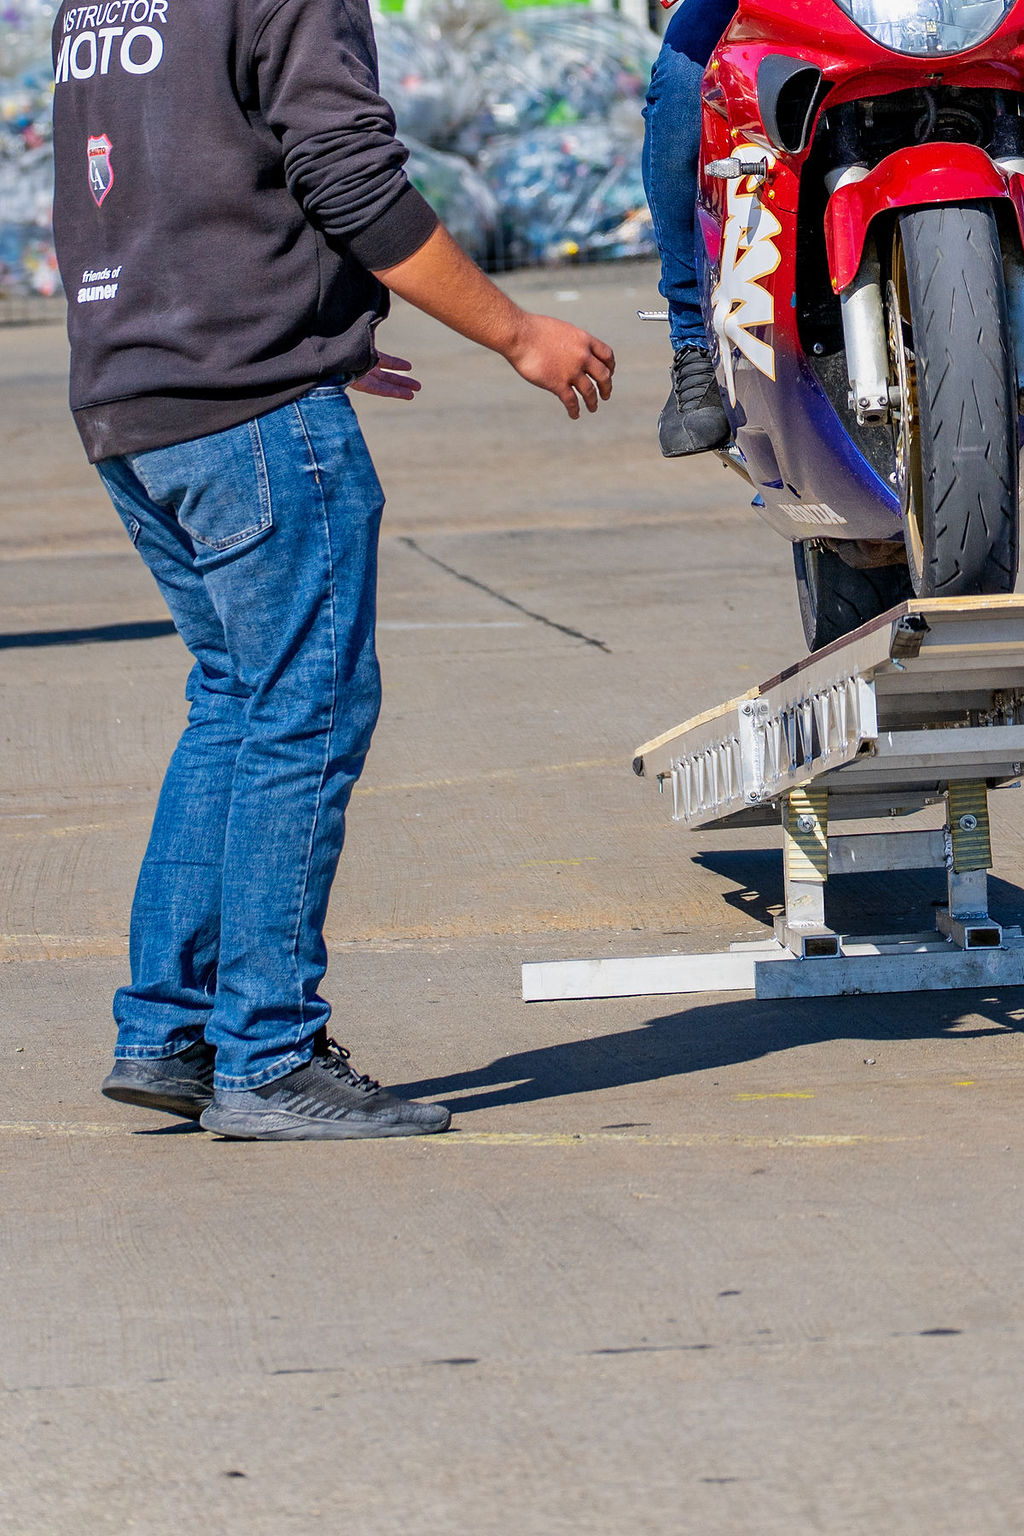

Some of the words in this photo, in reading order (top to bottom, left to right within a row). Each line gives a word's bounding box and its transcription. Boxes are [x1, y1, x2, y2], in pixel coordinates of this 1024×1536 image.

[63, 0, 169, 34] NSTRUCTOR
[82, 267, 111, 284] friends
[111, 265, 123, 279] of
[77, 283, 118, 304] auner
[777, 503, 848, 526] HONDA
